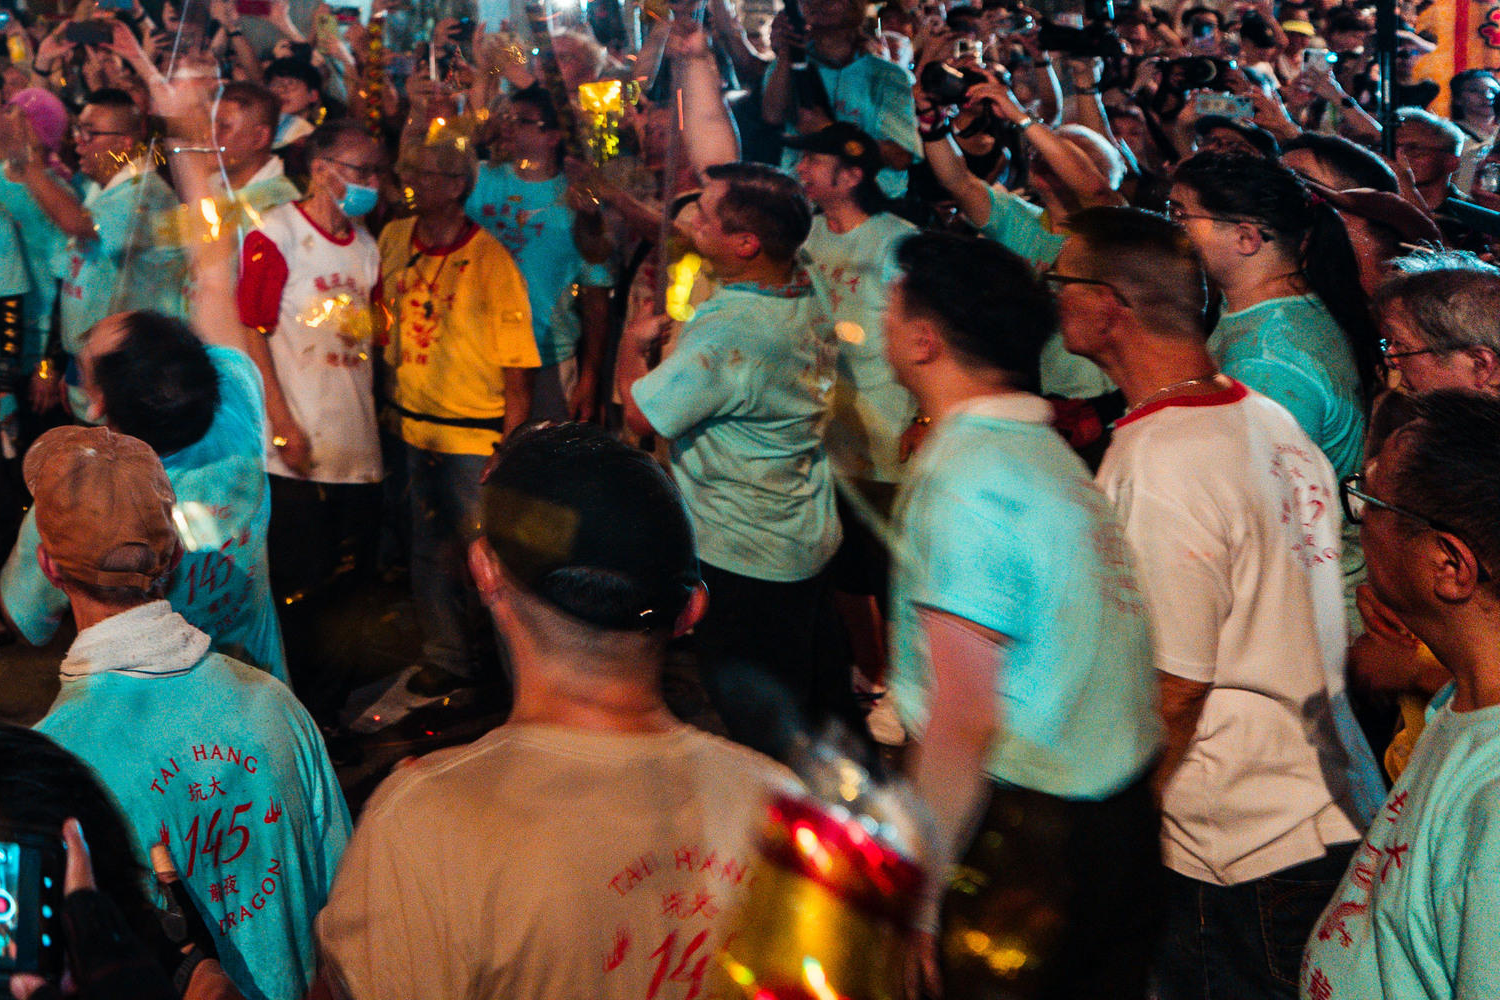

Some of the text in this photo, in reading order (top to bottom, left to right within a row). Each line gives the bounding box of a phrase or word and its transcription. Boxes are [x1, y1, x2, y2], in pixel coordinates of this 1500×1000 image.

[150, 744, 258, 795] TAI HANG
[184, 801, 253, 878] 145
[675, 846, 757, 890] HAN
